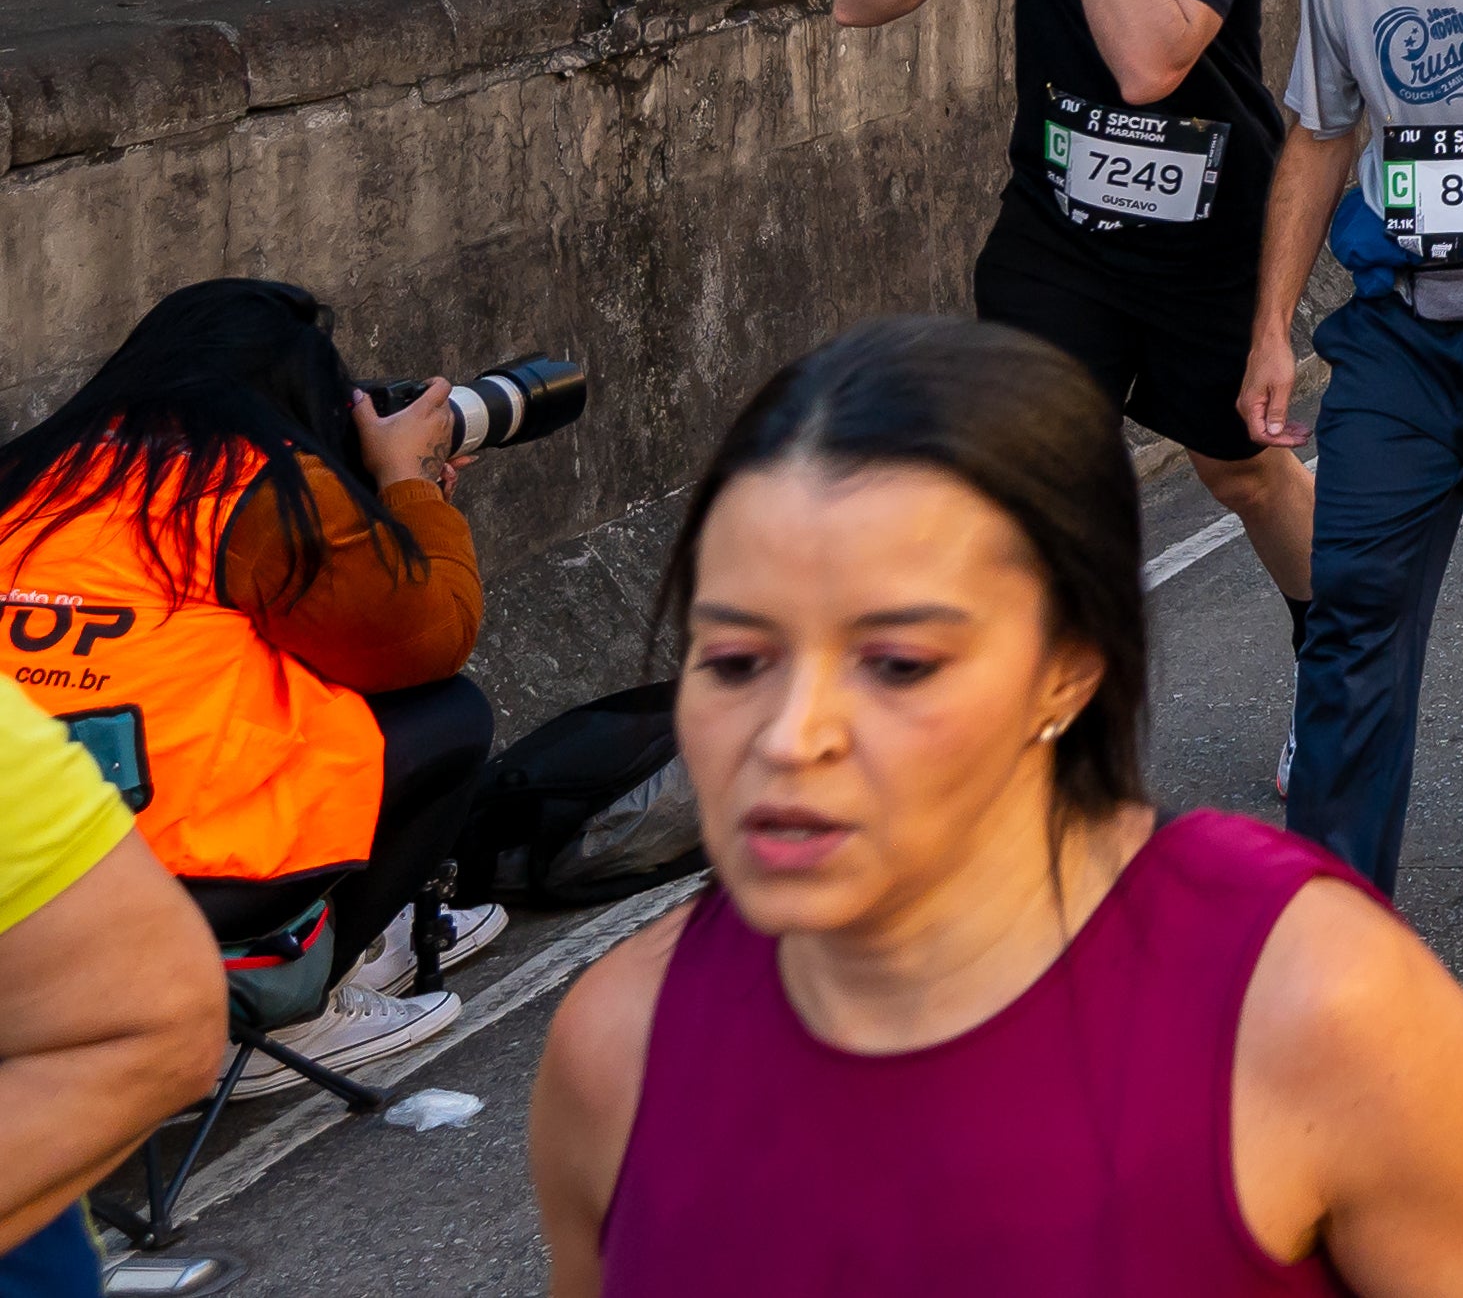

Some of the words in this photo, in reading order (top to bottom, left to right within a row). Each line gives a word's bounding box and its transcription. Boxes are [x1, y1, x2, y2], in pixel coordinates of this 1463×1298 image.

[1105, 126, 1165, 142] MARATHON
[1108, 113, 1168, 132] SPCITY
[1053, 133, 1066, 157] C
[1088, 151, 1183, 195] 7249
[1392, 172, 1408, 197] C
[1102, 194, 1157, 212] GUSTAVO
[15, 667, 110, 691] com.br
